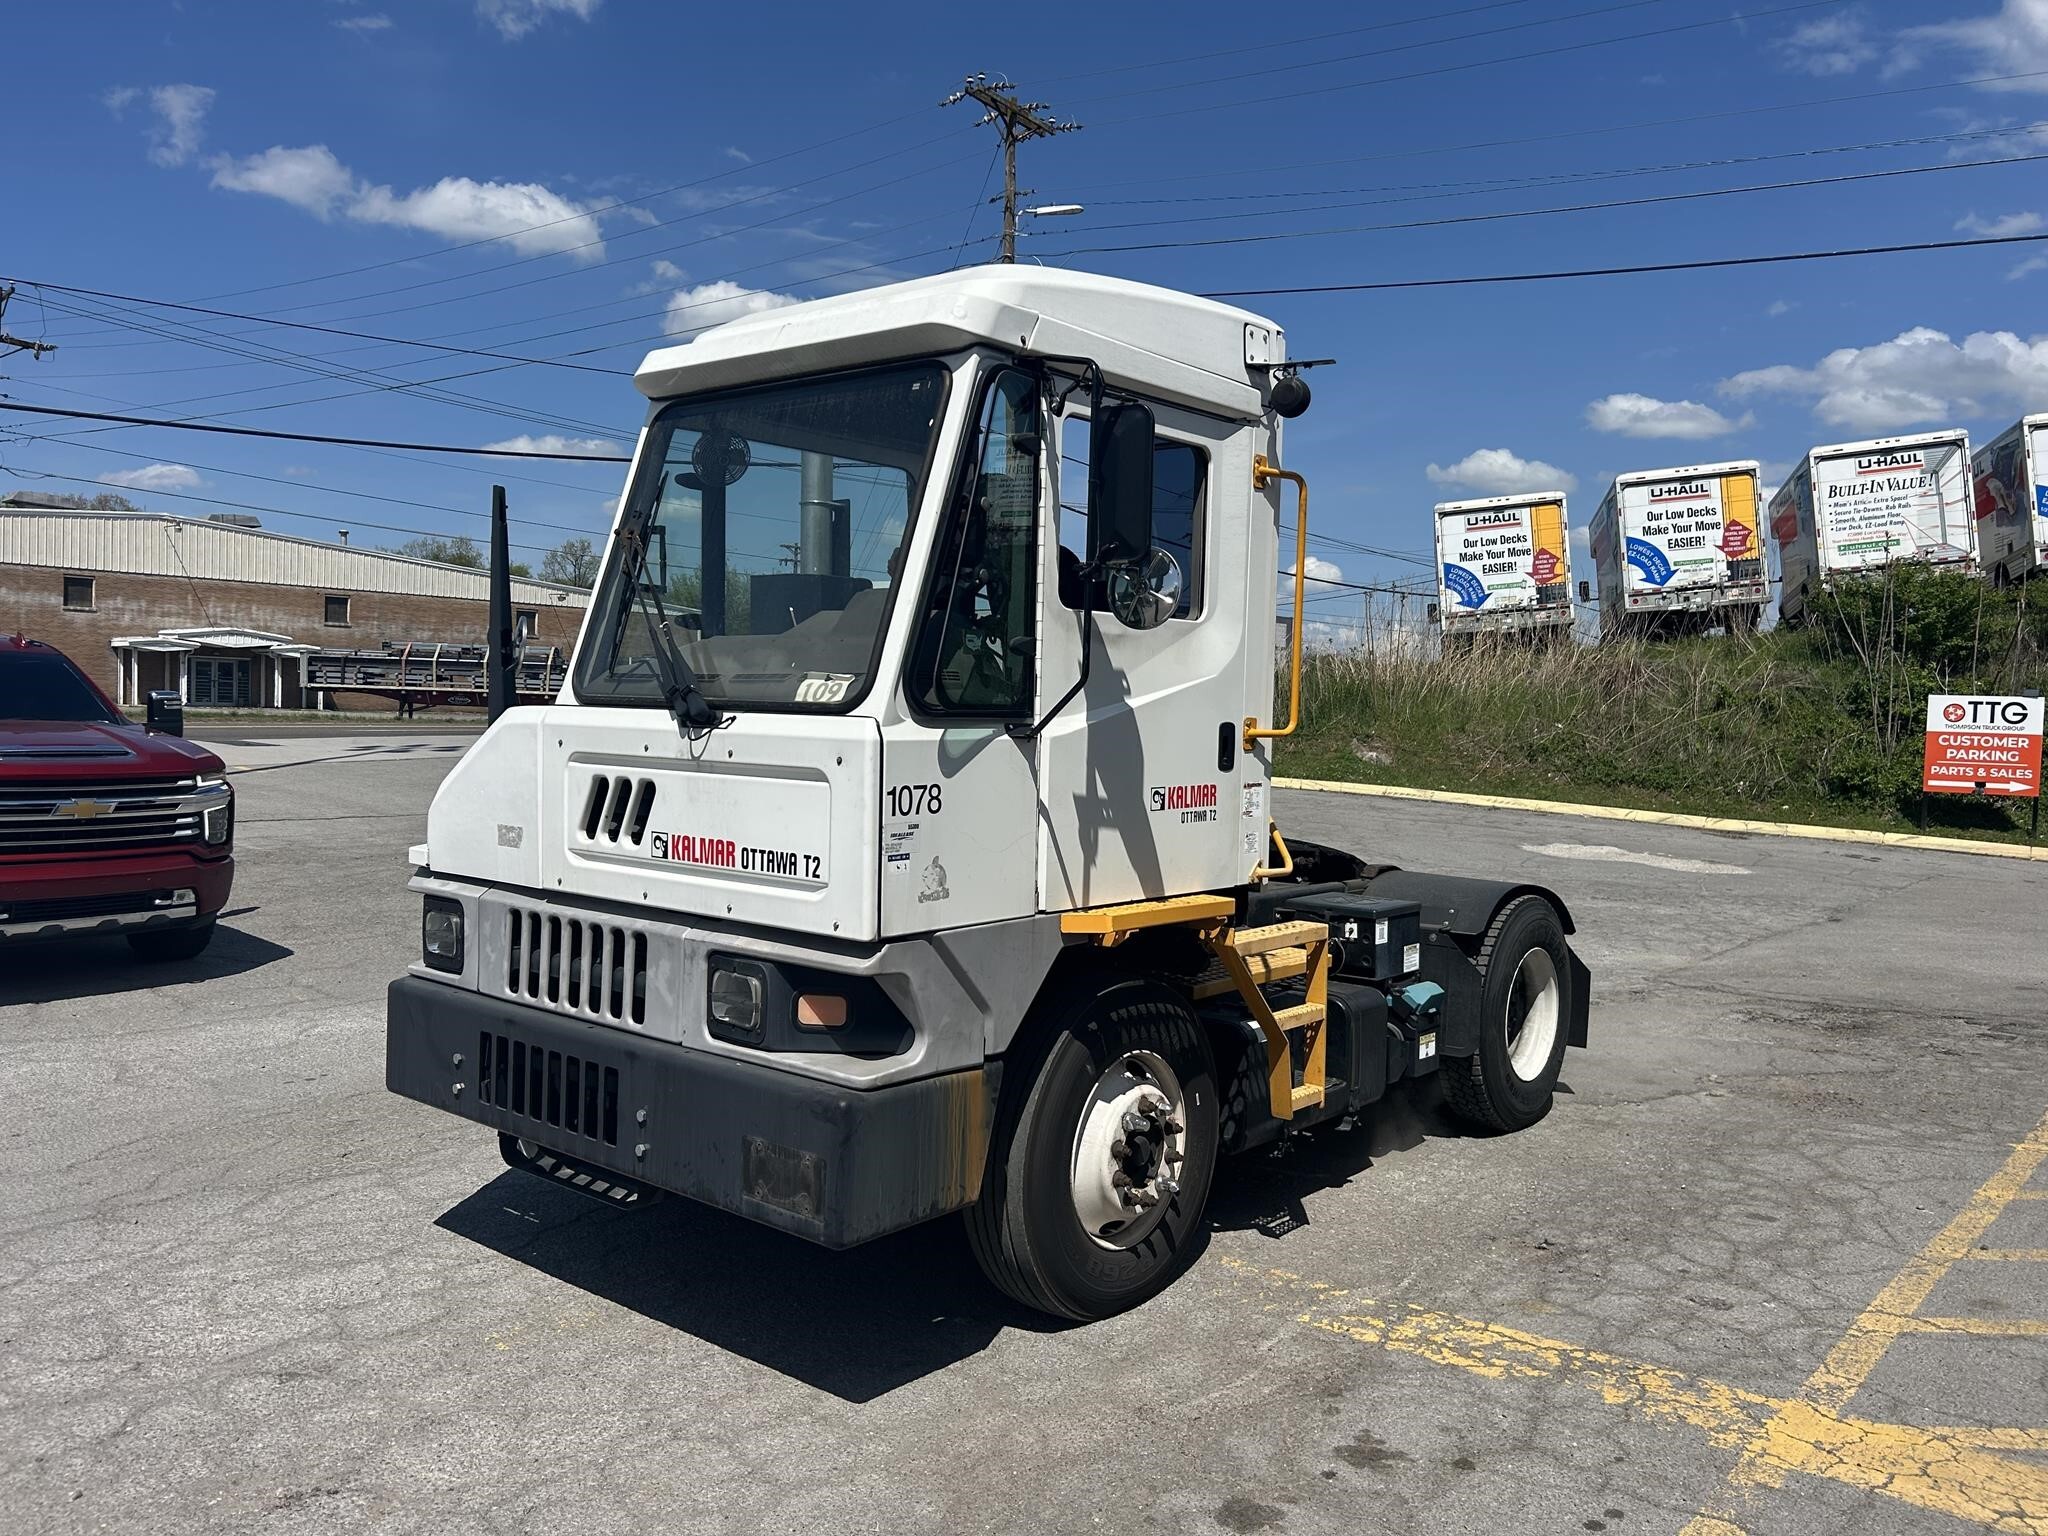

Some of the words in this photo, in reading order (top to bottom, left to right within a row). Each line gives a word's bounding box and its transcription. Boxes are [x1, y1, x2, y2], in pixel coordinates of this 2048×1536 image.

[1858, 453, 1922, 469] U-HAUL
[1650, 484, 1708, 498] U-HAUL
[1828, 478, 1885, 499] BUILT-IN
[1887, 472, 1934, 492] VALUE!
[1466, 512, 1520, 526] U-HAUL
[1647, 511, 1663, 522] Our
[1665, 509, 1684, 520] Low
[1687, 506, 1717, 518] Decks
[1858, 514, 1886, 522] Aluminum
[1642, 525, 1669, 537] Make
[1671, 522, 1693, 534] Your
[1695, 520, 1721, 532] Move
[1463, 538, 1479, 549] Our
[1480, 536, 1498, 547] Low
[1500, 533, 1528, 545] Decks
[1667, 535, 1706, 549] EASIER!
[1459, 551, 1484, 563] Make
[1485, 549, 1506, 560] Your
[1507, 547, 1532, 558] Move
[1628, 550, 1653, 568] EZ-LOAD
[1629, 543, 1654, 558] LOWEST
[1653, 556, 1667, 576] DECKS
[1482, 561, 1517, 575] EASIER!
[1450, 567, 1473, 581] LOWEST
[1470, 579, 1484, 598] DECKS
[802, 682, 843, 701] 109
[1968, 701, 2028, 725] TTG
[1938, 734, 2029, 748] CUSTOMER
[1946, 749, 2019, 762] PARKING
[1930, 765, 1974, 777] PARTS
[1976, 767, 1986, 777] &
[1989, 768, 2033, 779] SALES
[886, 783, 942, 817] 1078
[1167, 784, 1217, 810] KALMAR
[1180, 810, 1207, 824] OTTAWA
[1209, 809, 1217, 821] T2
[671, 834, 736, 868] KALMAR
[741, 847, 797, 876] OTTAWA
[803, 855, 821, 879] T2
